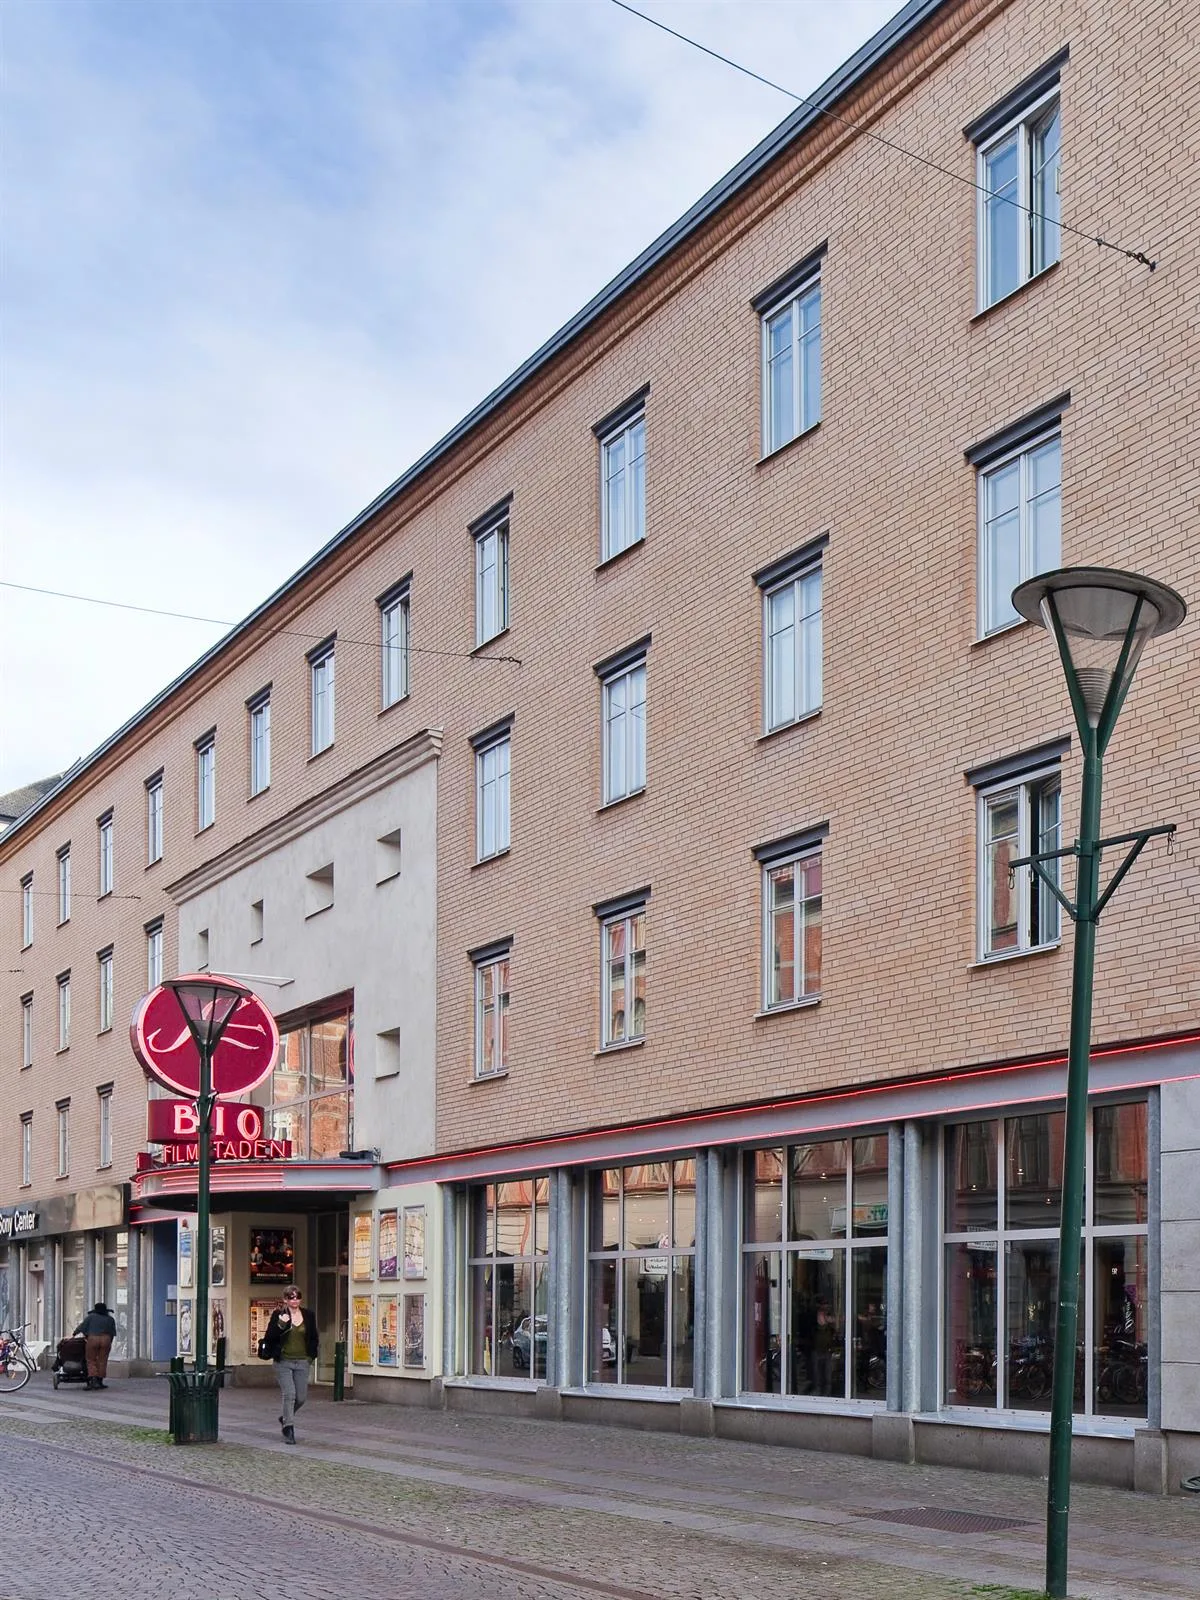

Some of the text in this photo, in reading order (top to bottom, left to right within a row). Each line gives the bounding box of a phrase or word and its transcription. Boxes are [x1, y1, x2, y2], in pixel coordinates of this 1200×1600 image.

[173, 1104, 261, 1141] BIO
[164, 1139, 287, 1163] FILMTADEN
[14, 1210, 36, 1233] Center
